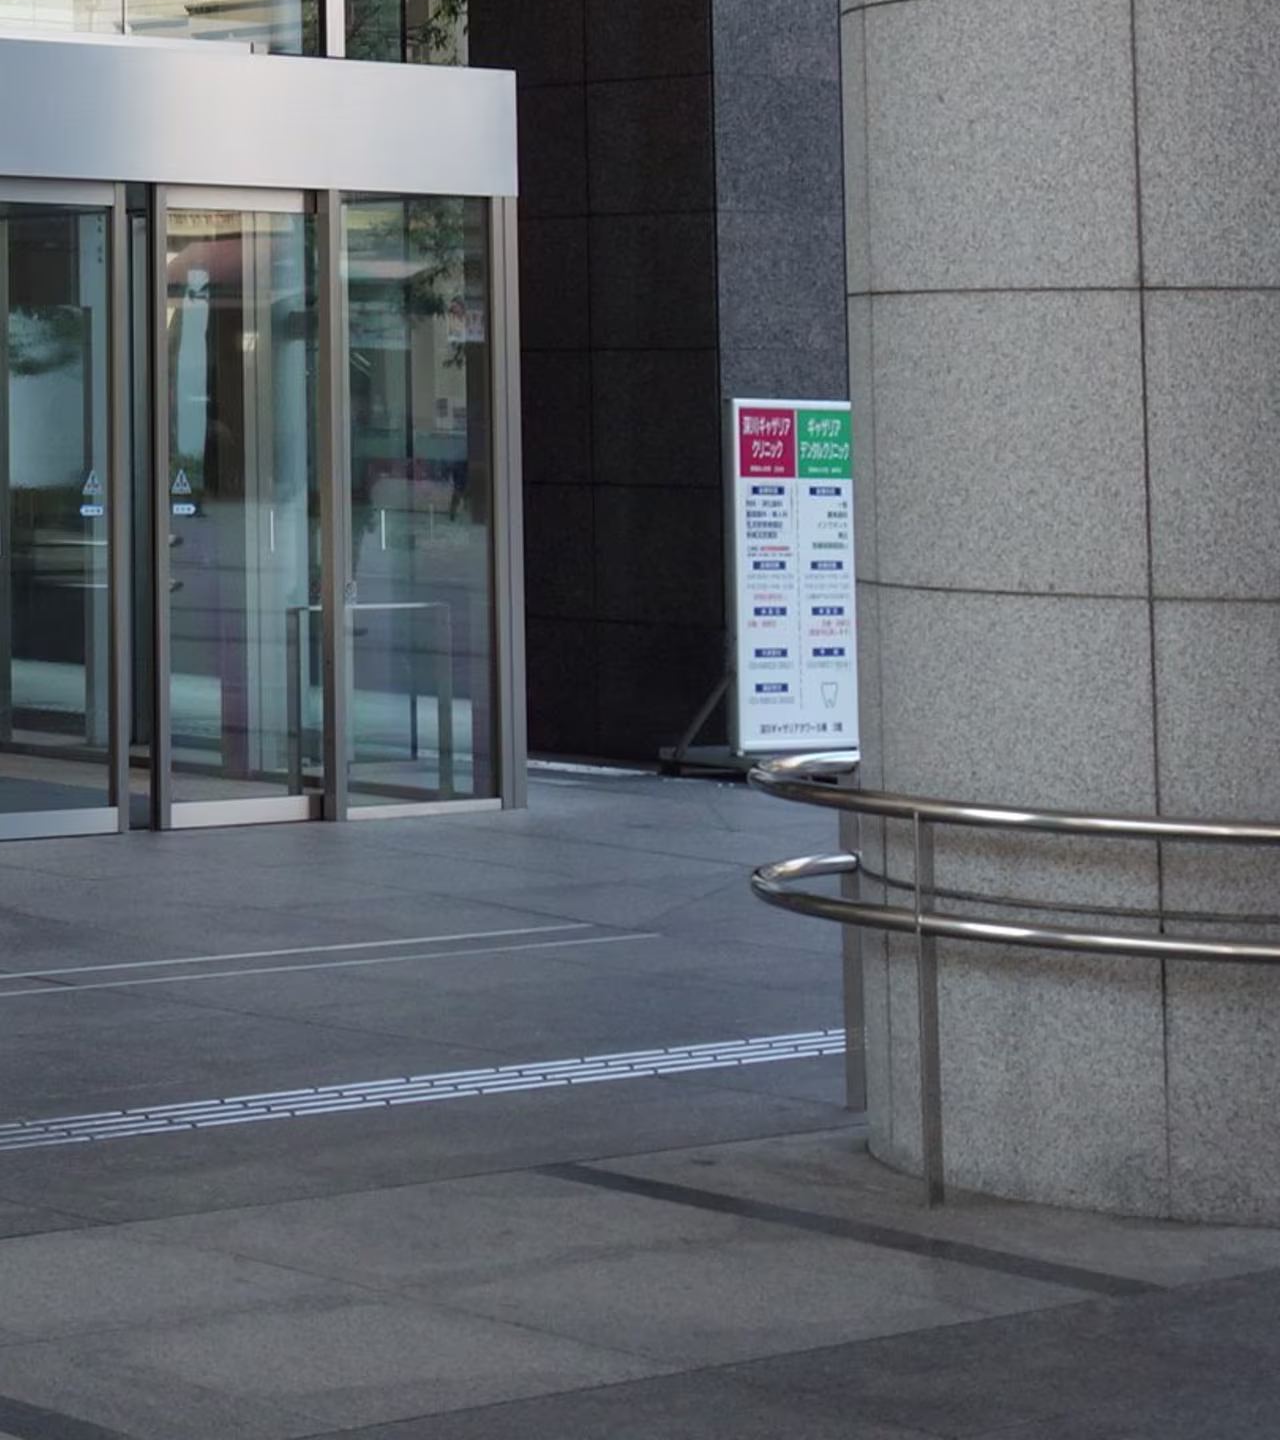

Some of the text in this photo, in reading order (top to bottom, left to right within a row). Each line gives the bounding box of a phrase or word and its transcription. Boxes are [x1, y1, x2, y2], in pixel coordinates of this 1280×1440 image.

[752, 440, 783, 459] クリニック
